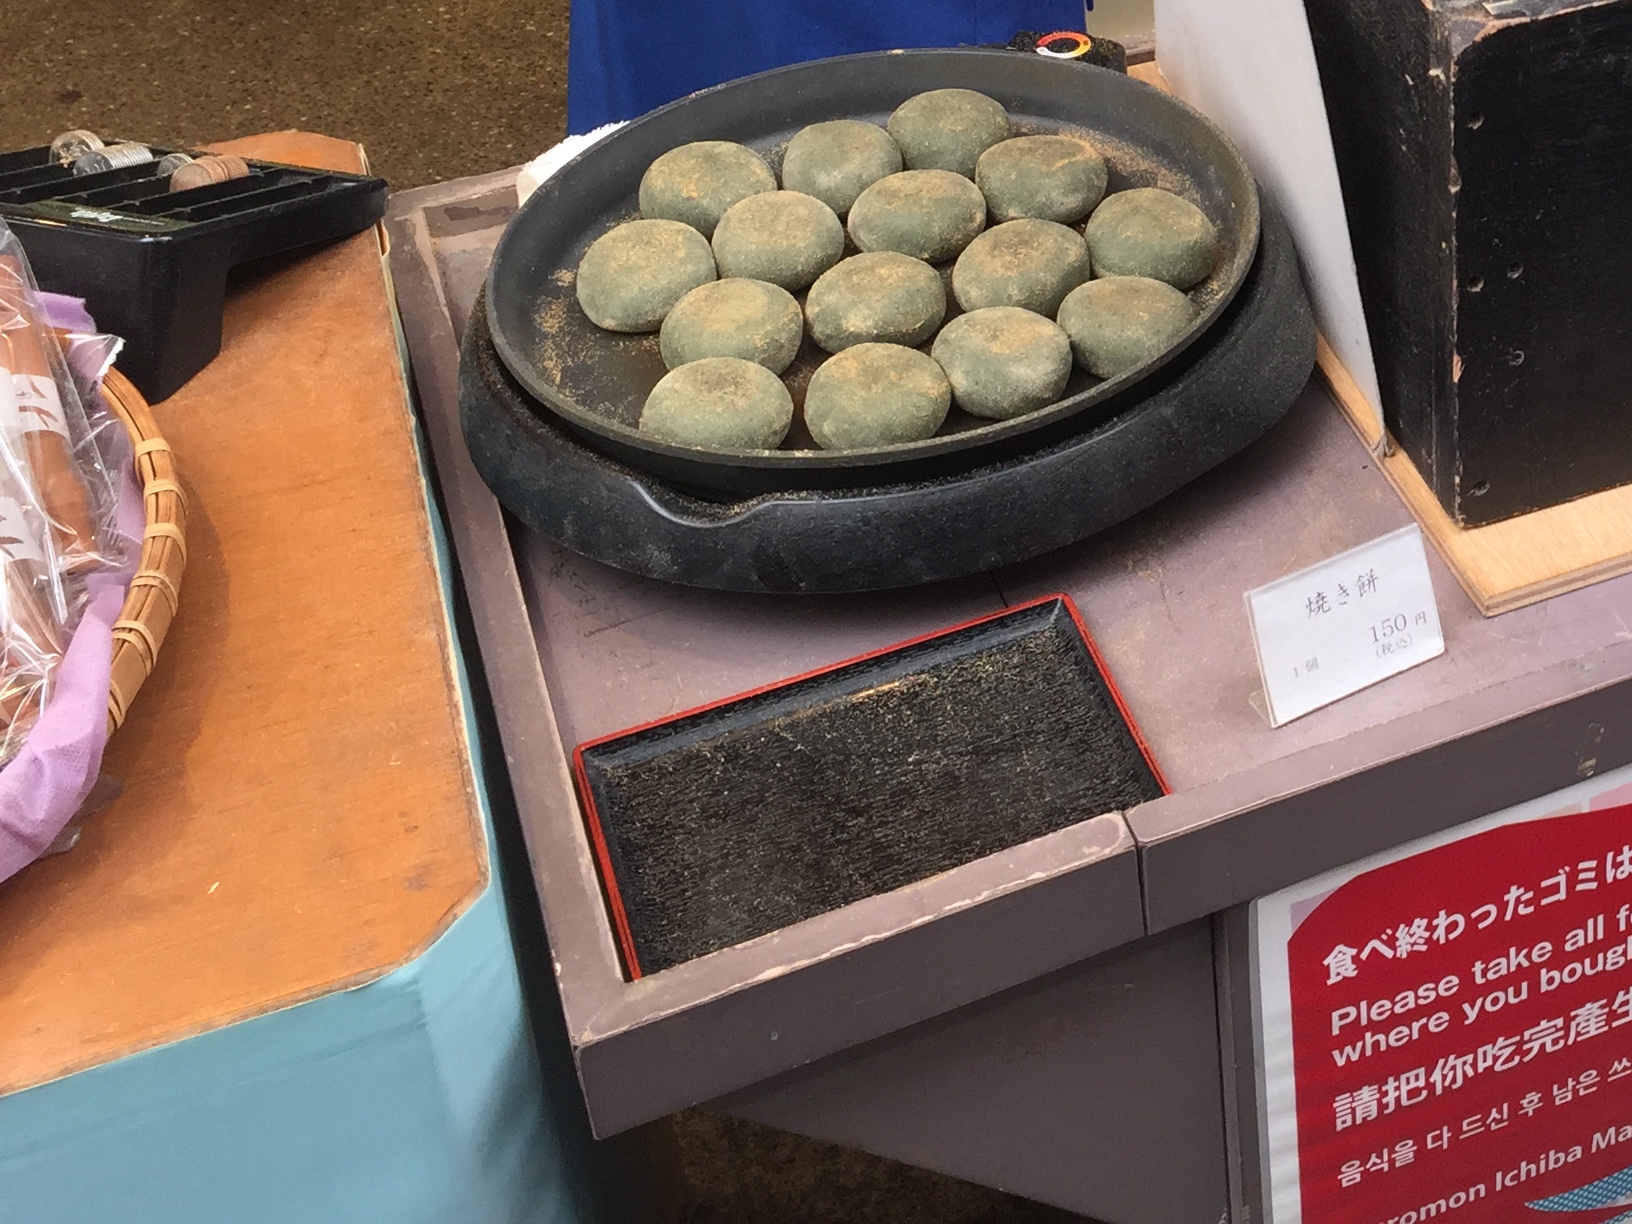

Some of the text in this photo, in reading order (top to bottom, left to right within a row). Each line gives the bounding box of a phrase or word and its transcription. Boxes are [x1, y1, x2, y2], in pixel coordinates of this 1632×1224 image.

[1305, 568, 1379, 620] 焼き餅
[1331, 975, 1460, 1036] Please
[1471, 940, 1553, 985] take
[1564, 914, 1605, 952] all
[1328, 1011, 1451, 1067] where
[1462, 981, 1529, 1026] you
[1337, 1139, 1418, 1188] 음식을
[1426, 1126, 1452, 1150] 다
[1459, 1103, 1509, 1139] 드신
[1517, 1091, 1544, 1117] 후
[1552, 1069, 1601, 1106] 남은
[1494, 1145, 1582, 1192] Ichiba
